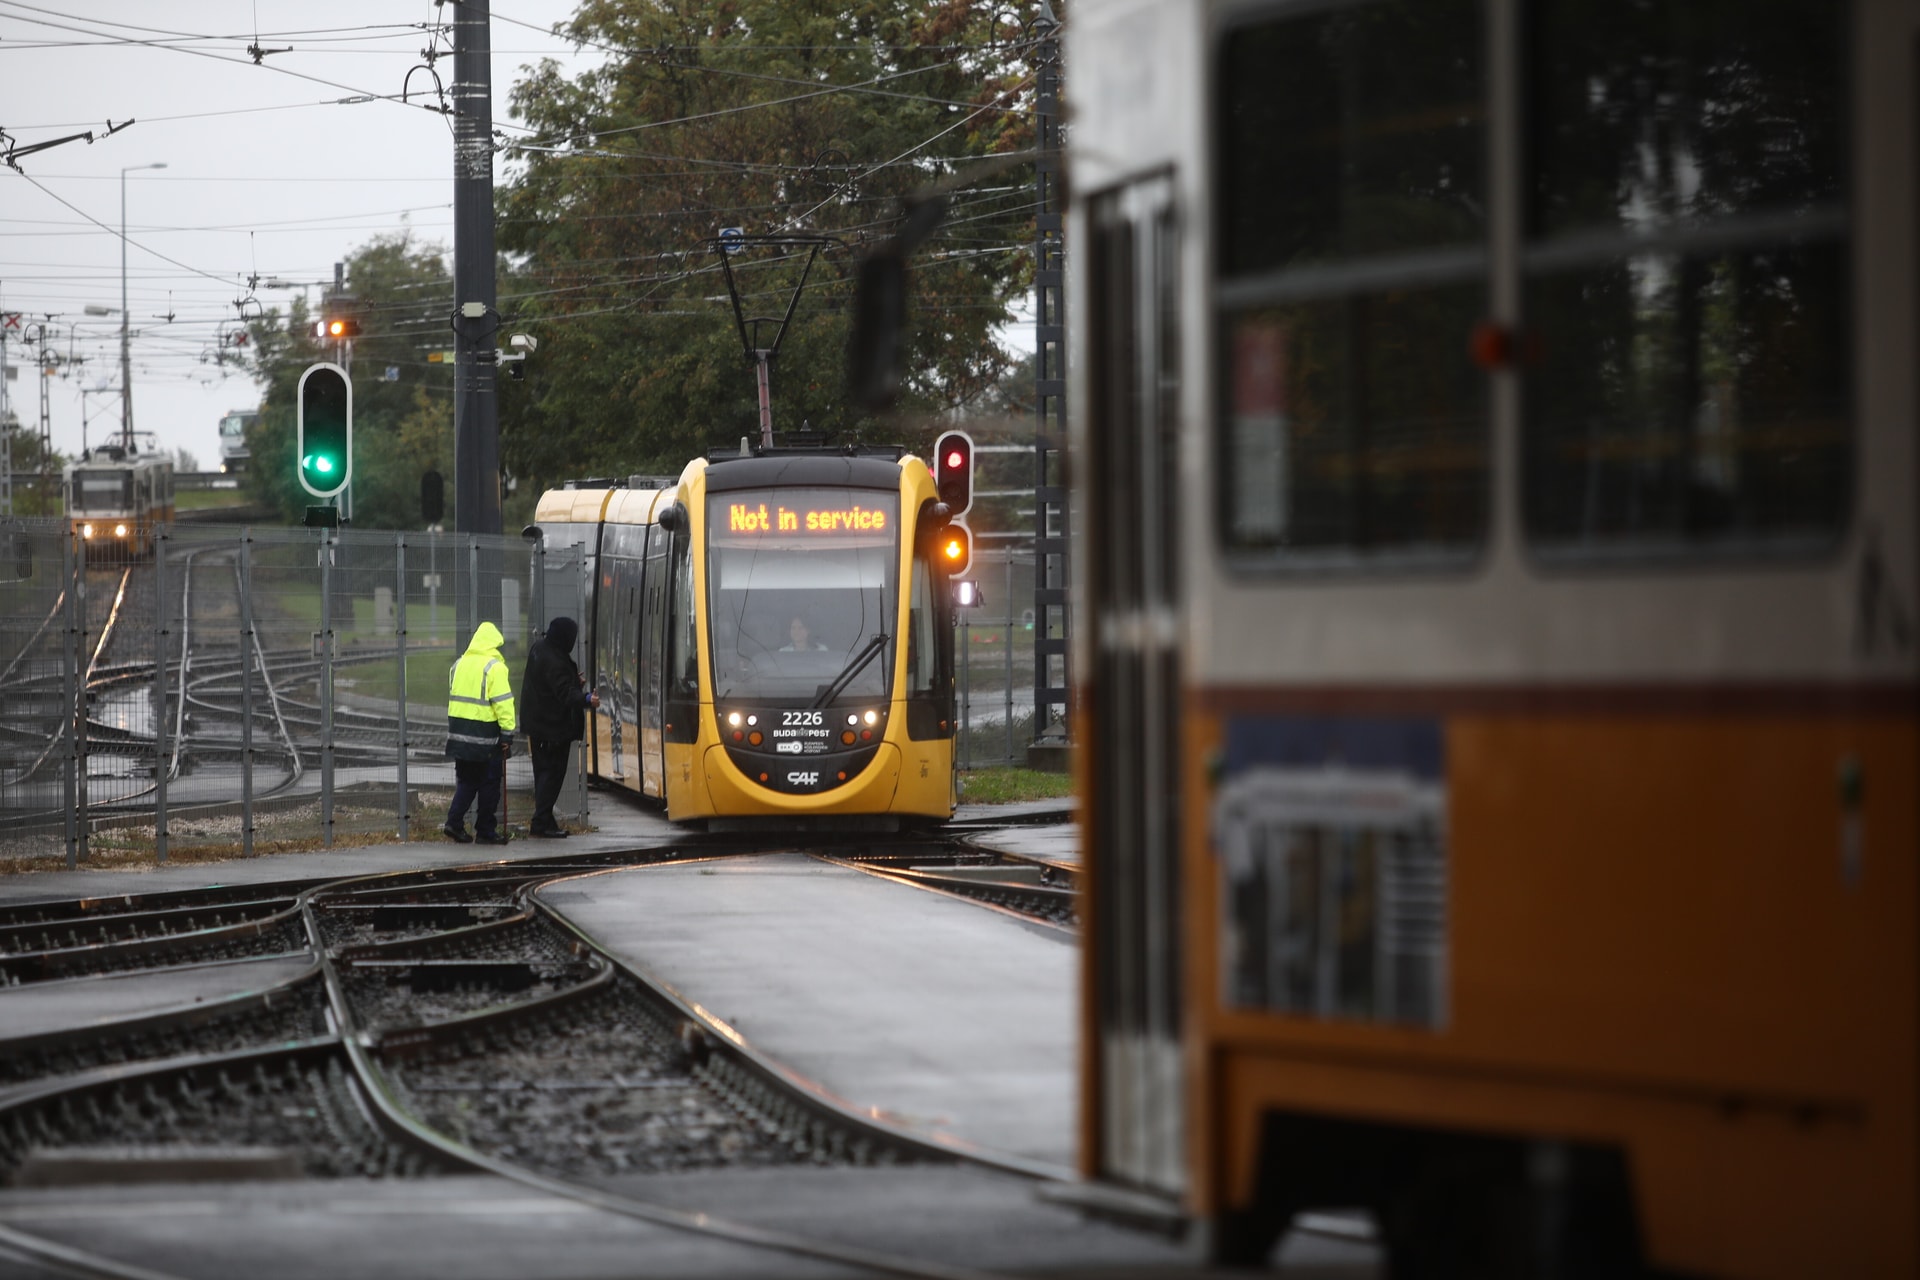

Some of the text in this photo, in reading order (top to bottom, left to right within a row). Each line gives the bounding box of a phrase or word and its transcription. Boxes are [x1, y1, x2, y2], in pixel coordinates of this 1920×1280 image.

[730, 504, 885, 531] Not in service
[782, 711, 823, 726] 2226
[787, 772, 819, 785] CAF
